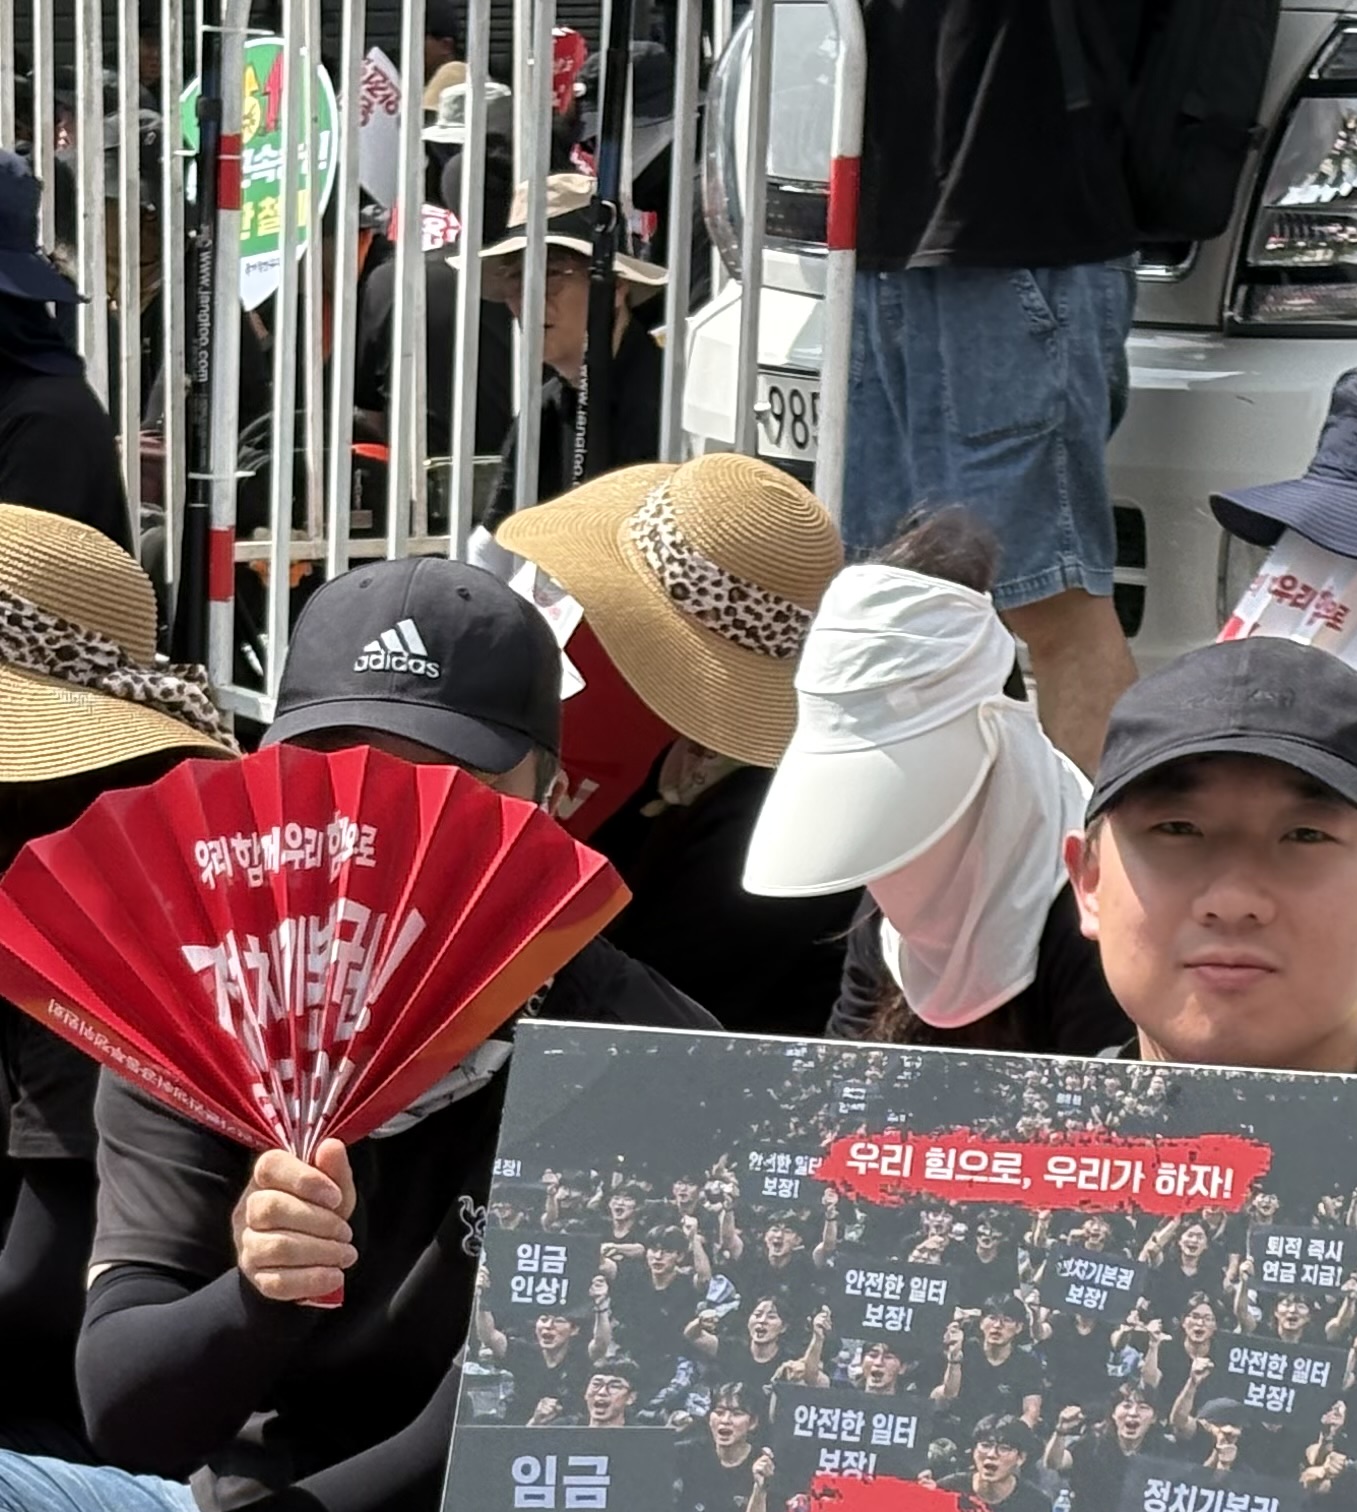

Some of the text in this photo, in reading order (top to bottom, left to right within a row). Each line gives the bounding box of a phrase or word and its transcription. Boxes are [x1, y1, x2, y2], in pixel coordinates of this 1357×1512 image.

[353, 648, 440, 679] adidas
[281, 822, 323, 870] 우리
[846, 1141, 1233, 1199] 우리 힘으로, 우리가 하자!
[761, 1176, 800, 1199] 보장!
[516, 1243, 568, 1274] 임금
[1265, 1235, 1344, 1262] 퇴직 즉시
[845, 1269, 948, 1306] 안전한 일터
[1262, 1261, 1343, 1288] 연금 지급!
[510, 1276, 569, 1305] 인상!
[1065, 1283, 1108, 1311] 보장!
[862, 1302, 914, 1333] 보장!
[1227, 1346, 1331, 1388] 안전한 일터
[1243, 1382, 1296, 1414] 보장!
[793, 1404, 918, 1448] 안전한 일터
[815, 1446, 877, 1481] 보장!
[510, 1454, 611, 1510] 임금
